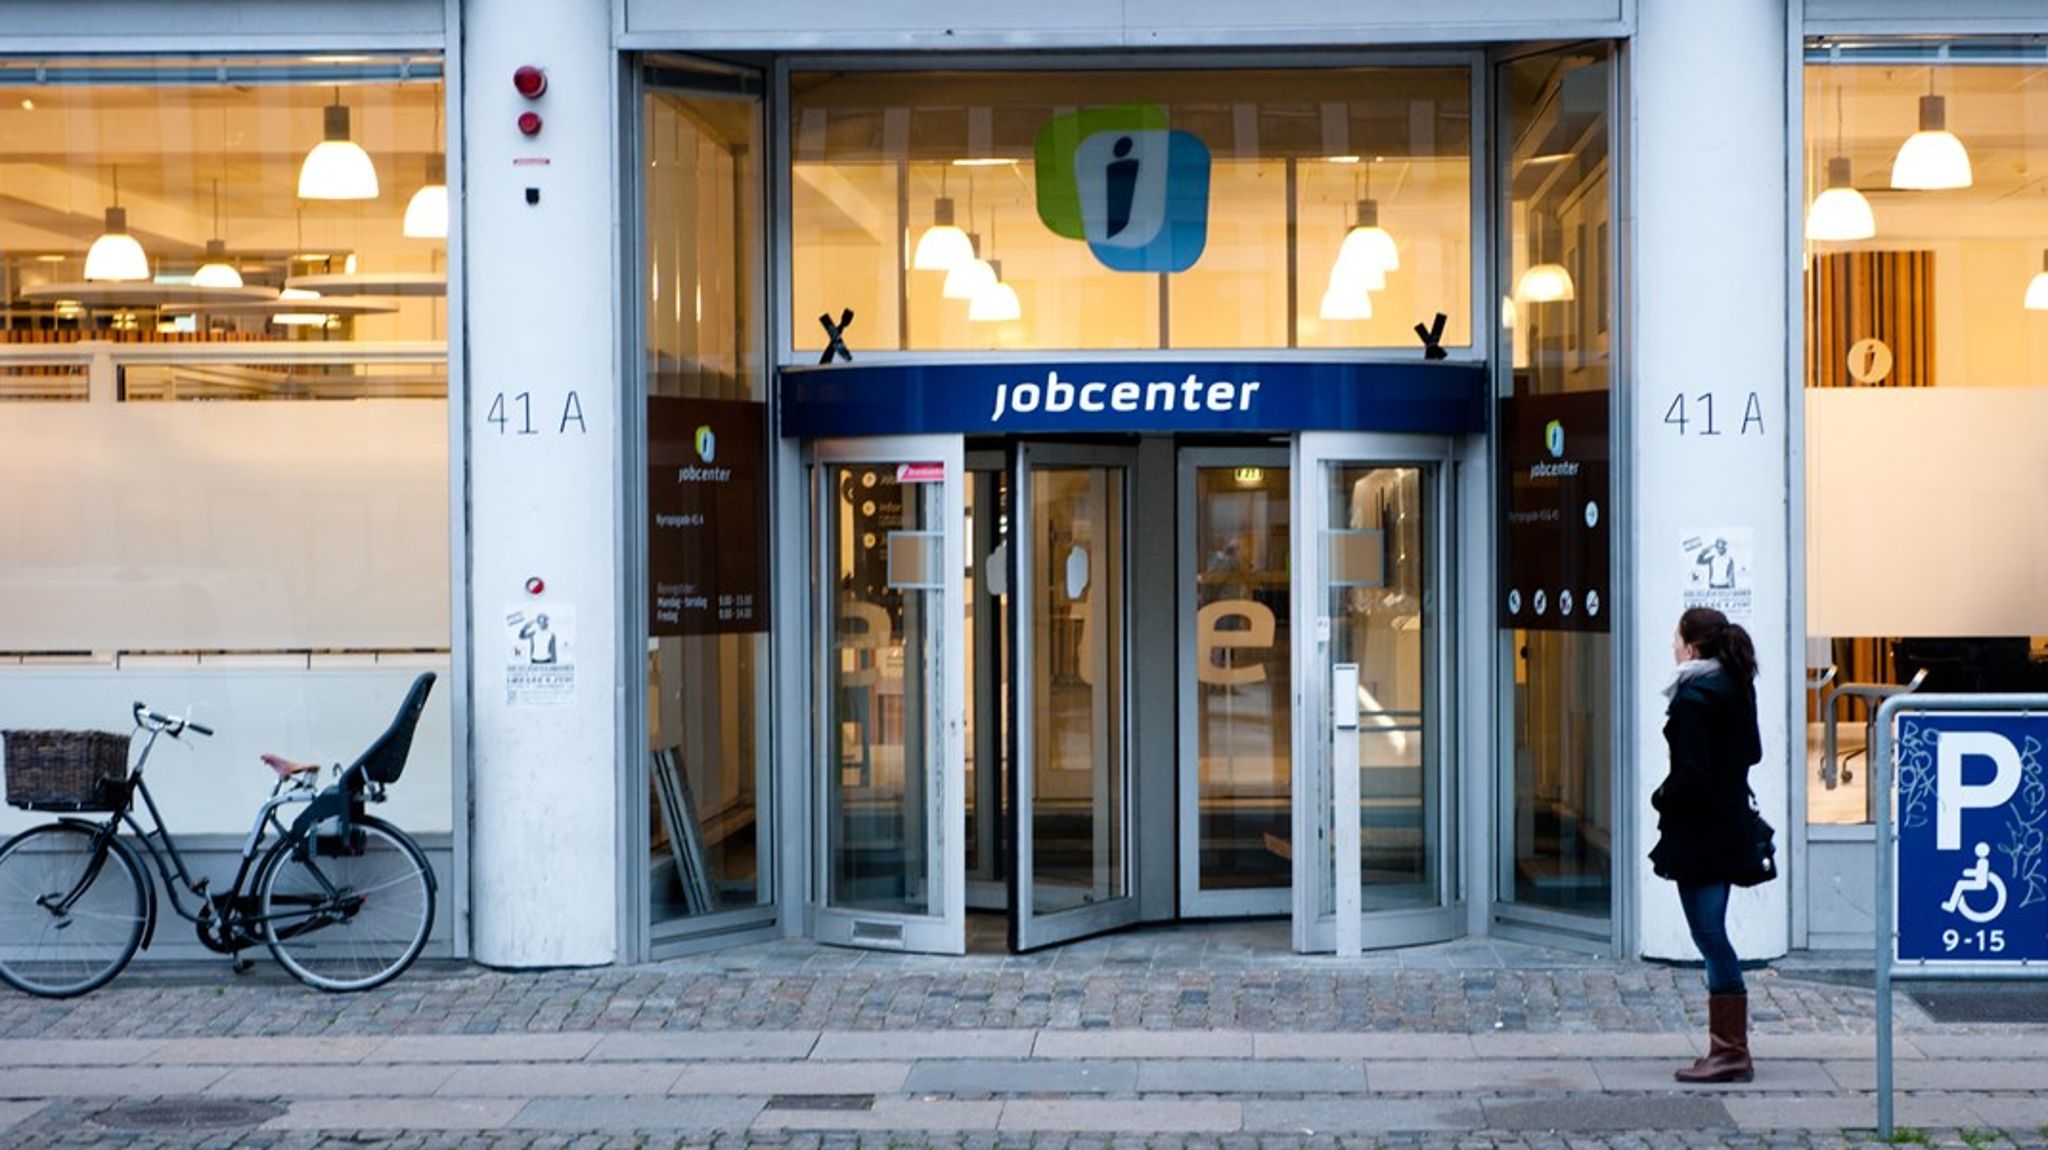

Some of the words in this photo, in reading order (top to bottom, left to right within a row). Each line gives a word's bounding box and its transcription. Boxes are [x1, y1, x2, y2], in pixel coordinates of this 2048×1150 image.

[487, 391, 539, 435] 41
[559, 390, 587, 435] A
[991, 371, 1261, 422] jobcenter
[1664, 391, 1722, 436] 41
[1740, 391, 1765, 435] A
[678, 465, 731, 484] jobcenter
[1530, 460, 1580, 481] jobcenter
[1936, 731, 2023, 851] P
